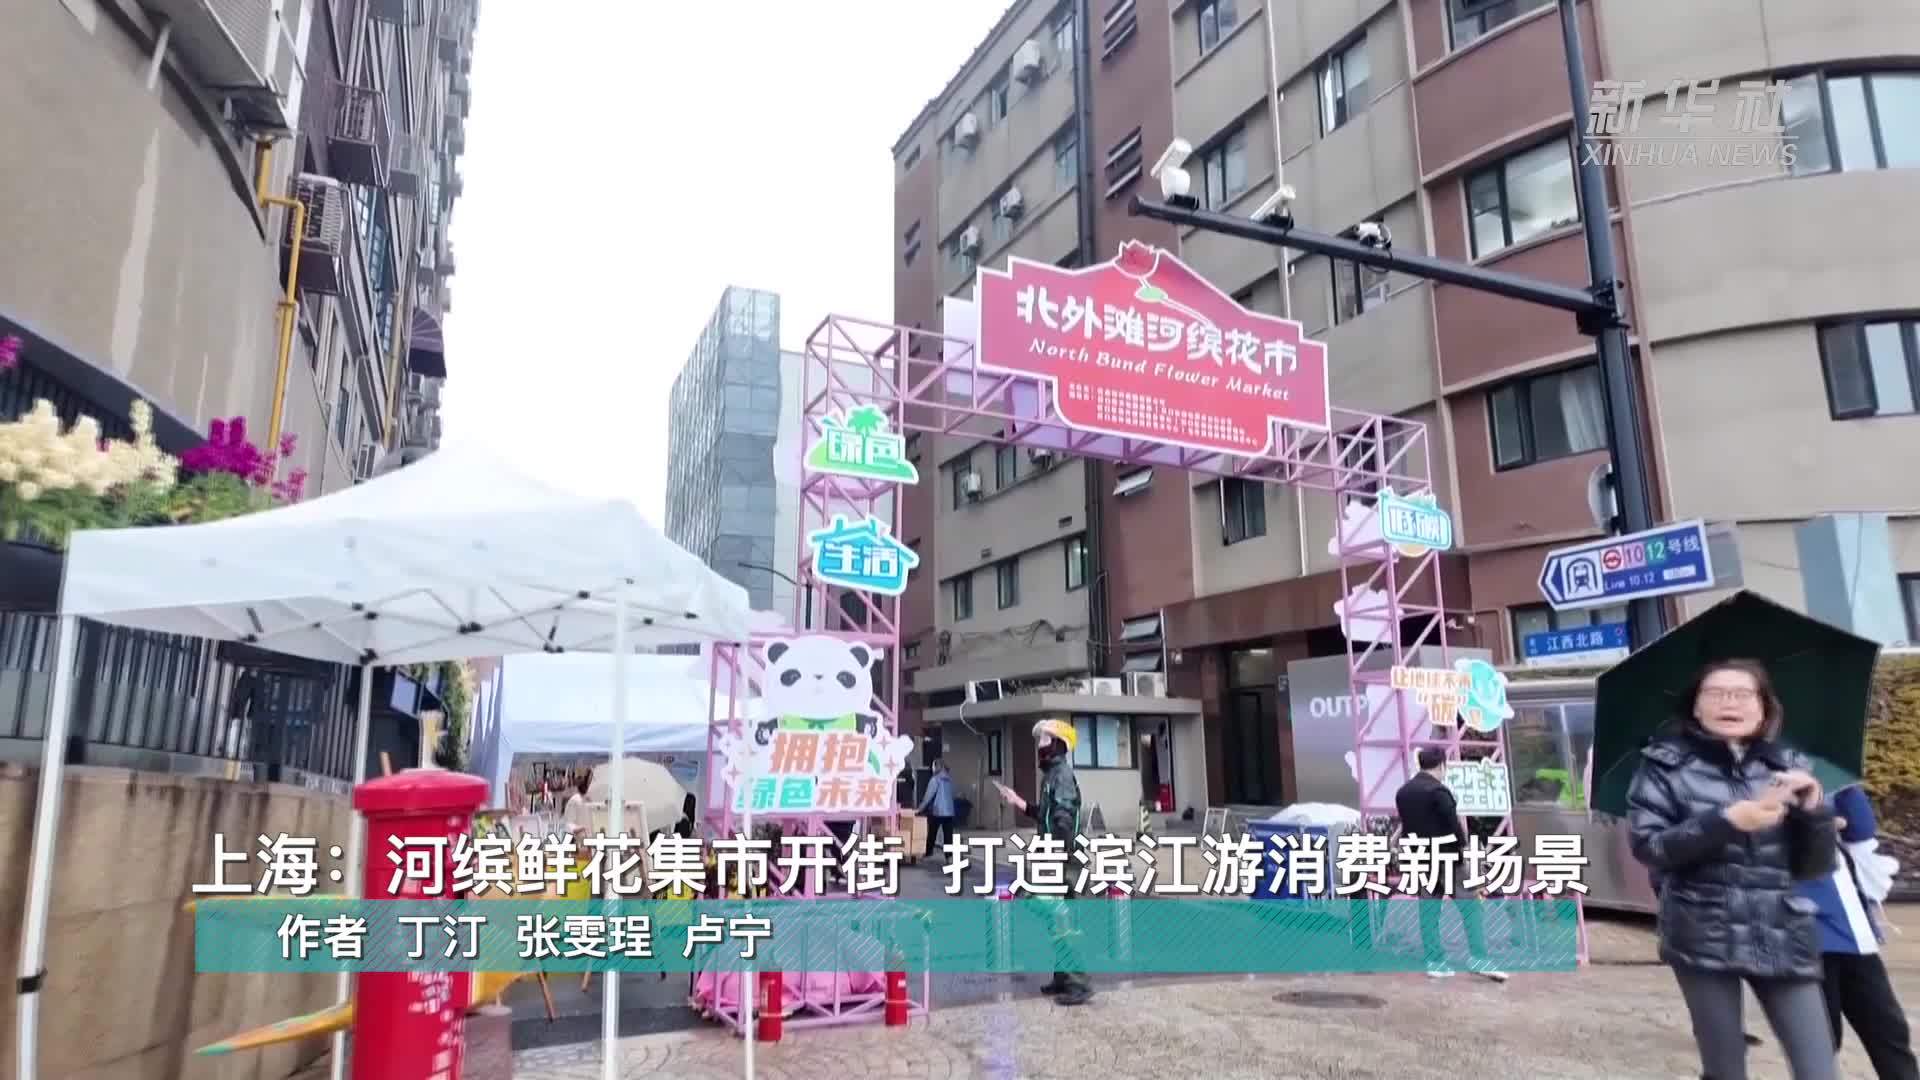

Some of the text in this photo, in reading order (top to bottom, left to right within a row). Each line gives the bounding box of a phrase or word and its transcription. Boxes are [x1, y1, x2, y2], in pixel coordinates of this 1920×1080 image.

[1015, 283, 1298, 377] 北外滩河缤花市
[1029, 338, 1291, 401] North Bund Flower Market
[826, 429, 902, 467] 绿色
[824, 540, 900, 577] 生活
[1625, 535, 1701, 563] 10 12 号线
[1604, 579, 1626, 591] Line
[1546, 631, 1604, 651] 江西北路
[768, 732, 868, 774] 拥抱
[736, 776, 887, 809] 绿色未来
